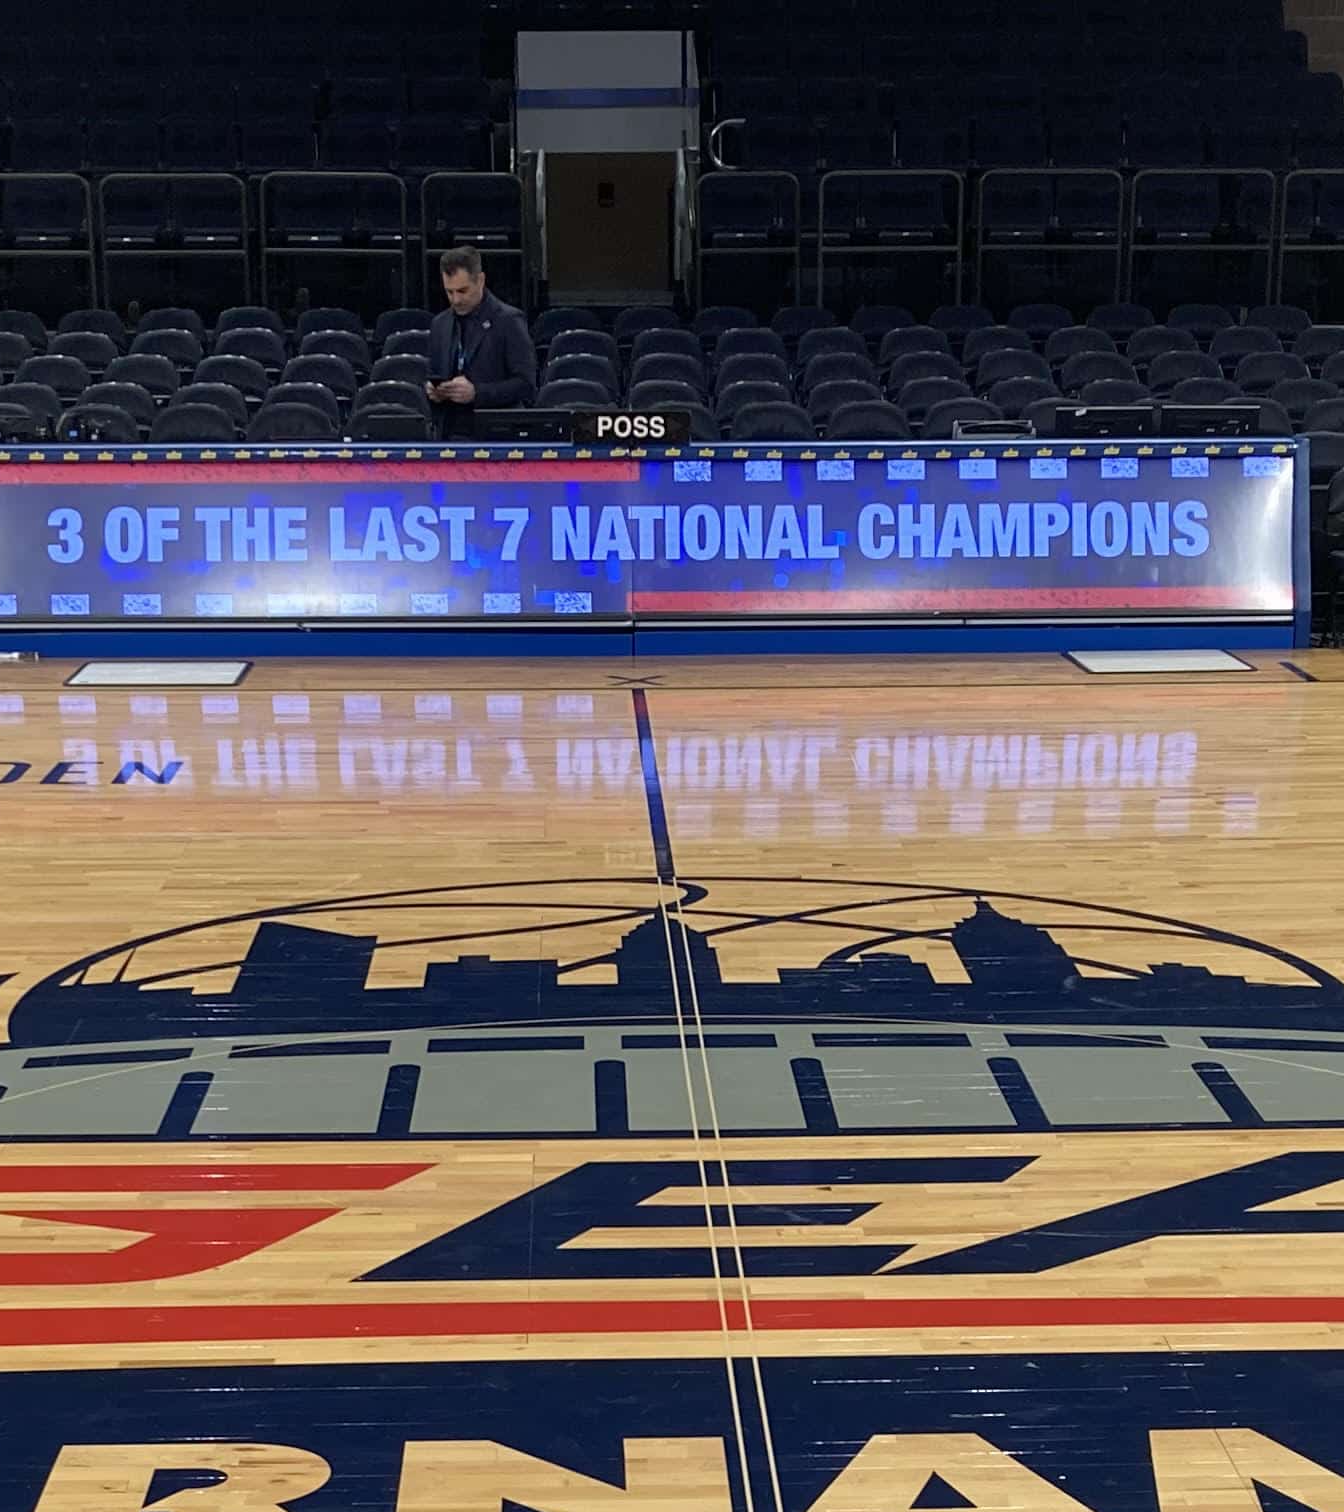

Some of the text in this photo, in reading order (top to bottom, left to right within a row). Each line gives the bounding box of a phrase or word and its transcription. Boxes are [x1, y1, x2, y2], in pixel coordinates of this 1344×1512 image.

[597, 415, 666, 438] POSS
[47, 500, 1211, 564] 3 OF THE LAST 7 NATIONAL CHAMPIONS
